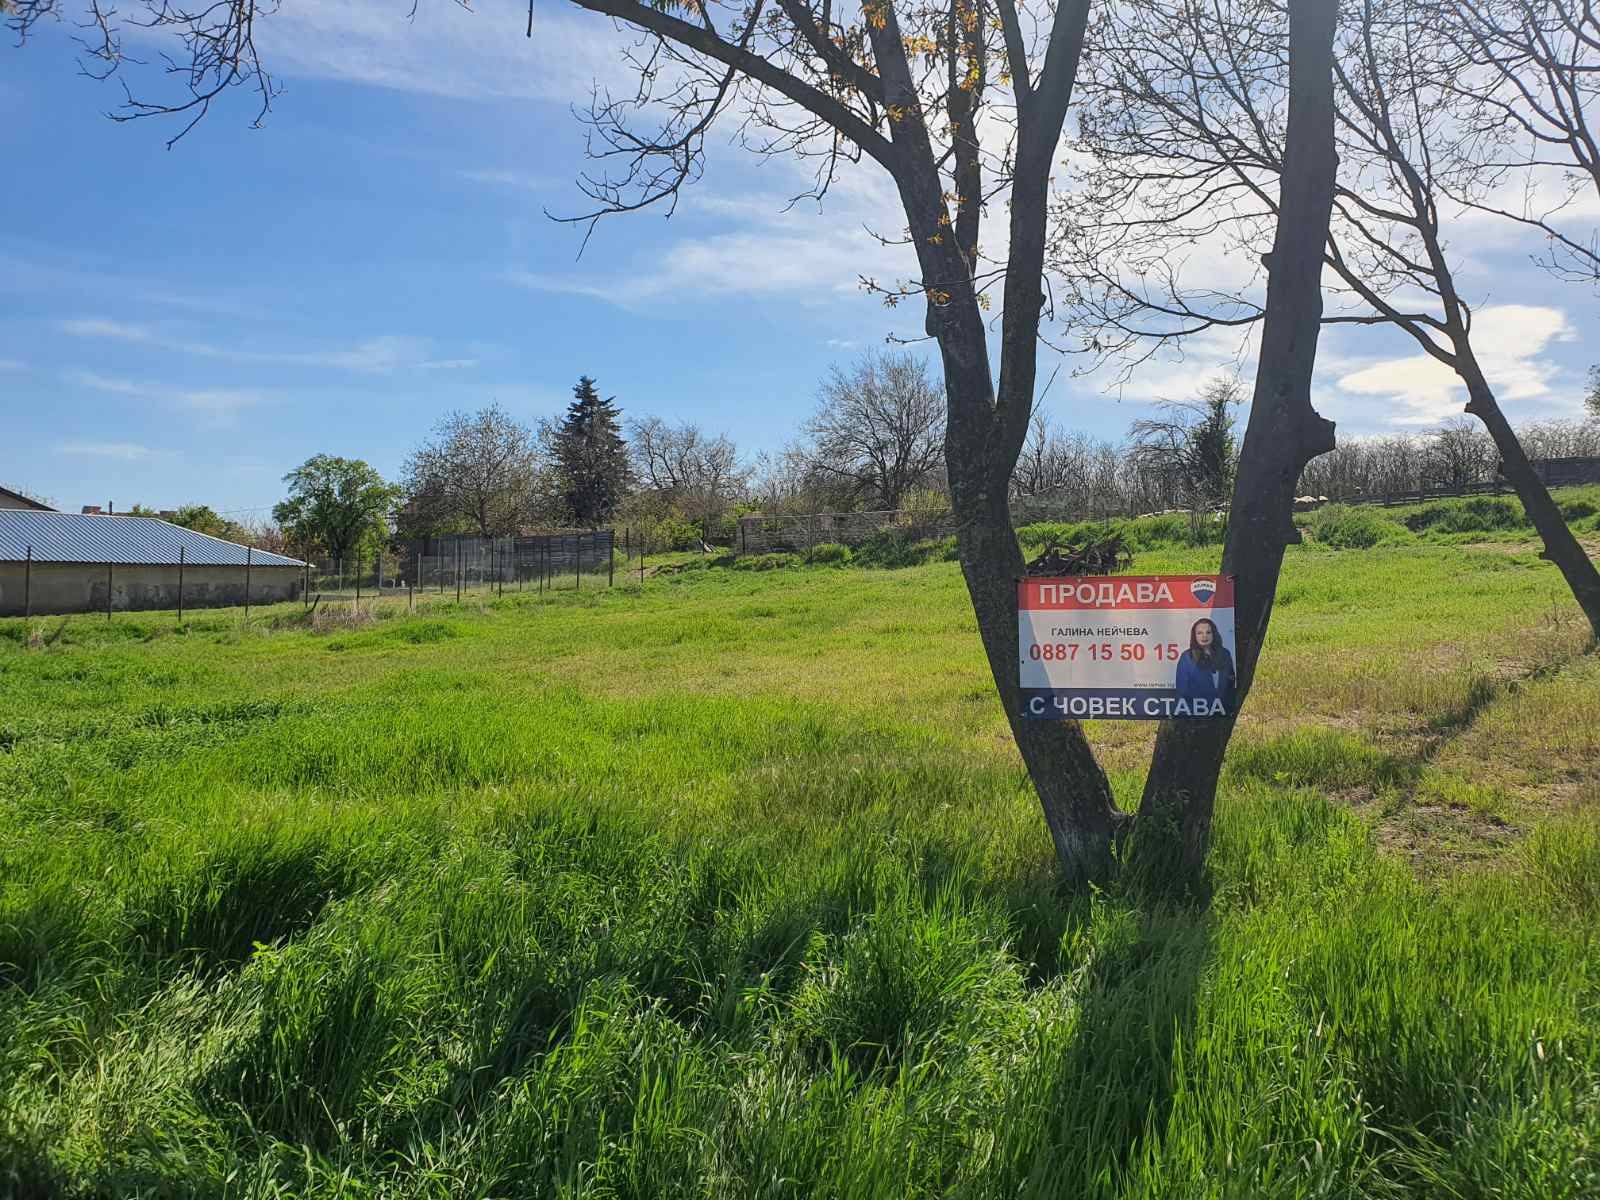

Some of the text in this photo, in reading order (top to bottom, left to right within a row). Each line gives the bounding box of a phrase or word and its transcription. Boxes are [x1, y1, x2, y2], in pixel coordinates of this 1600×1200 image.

[1039, 583, 1174, 607] ПРОДАВА
[1051, 626, 1149, 637] ГАЛИНА НЕЙЧЕВА
[1029, 644, 1180, 661] 0887 15 50 15
[1029, 697, 1226, 716] С ЧОВЕК СТАВА
